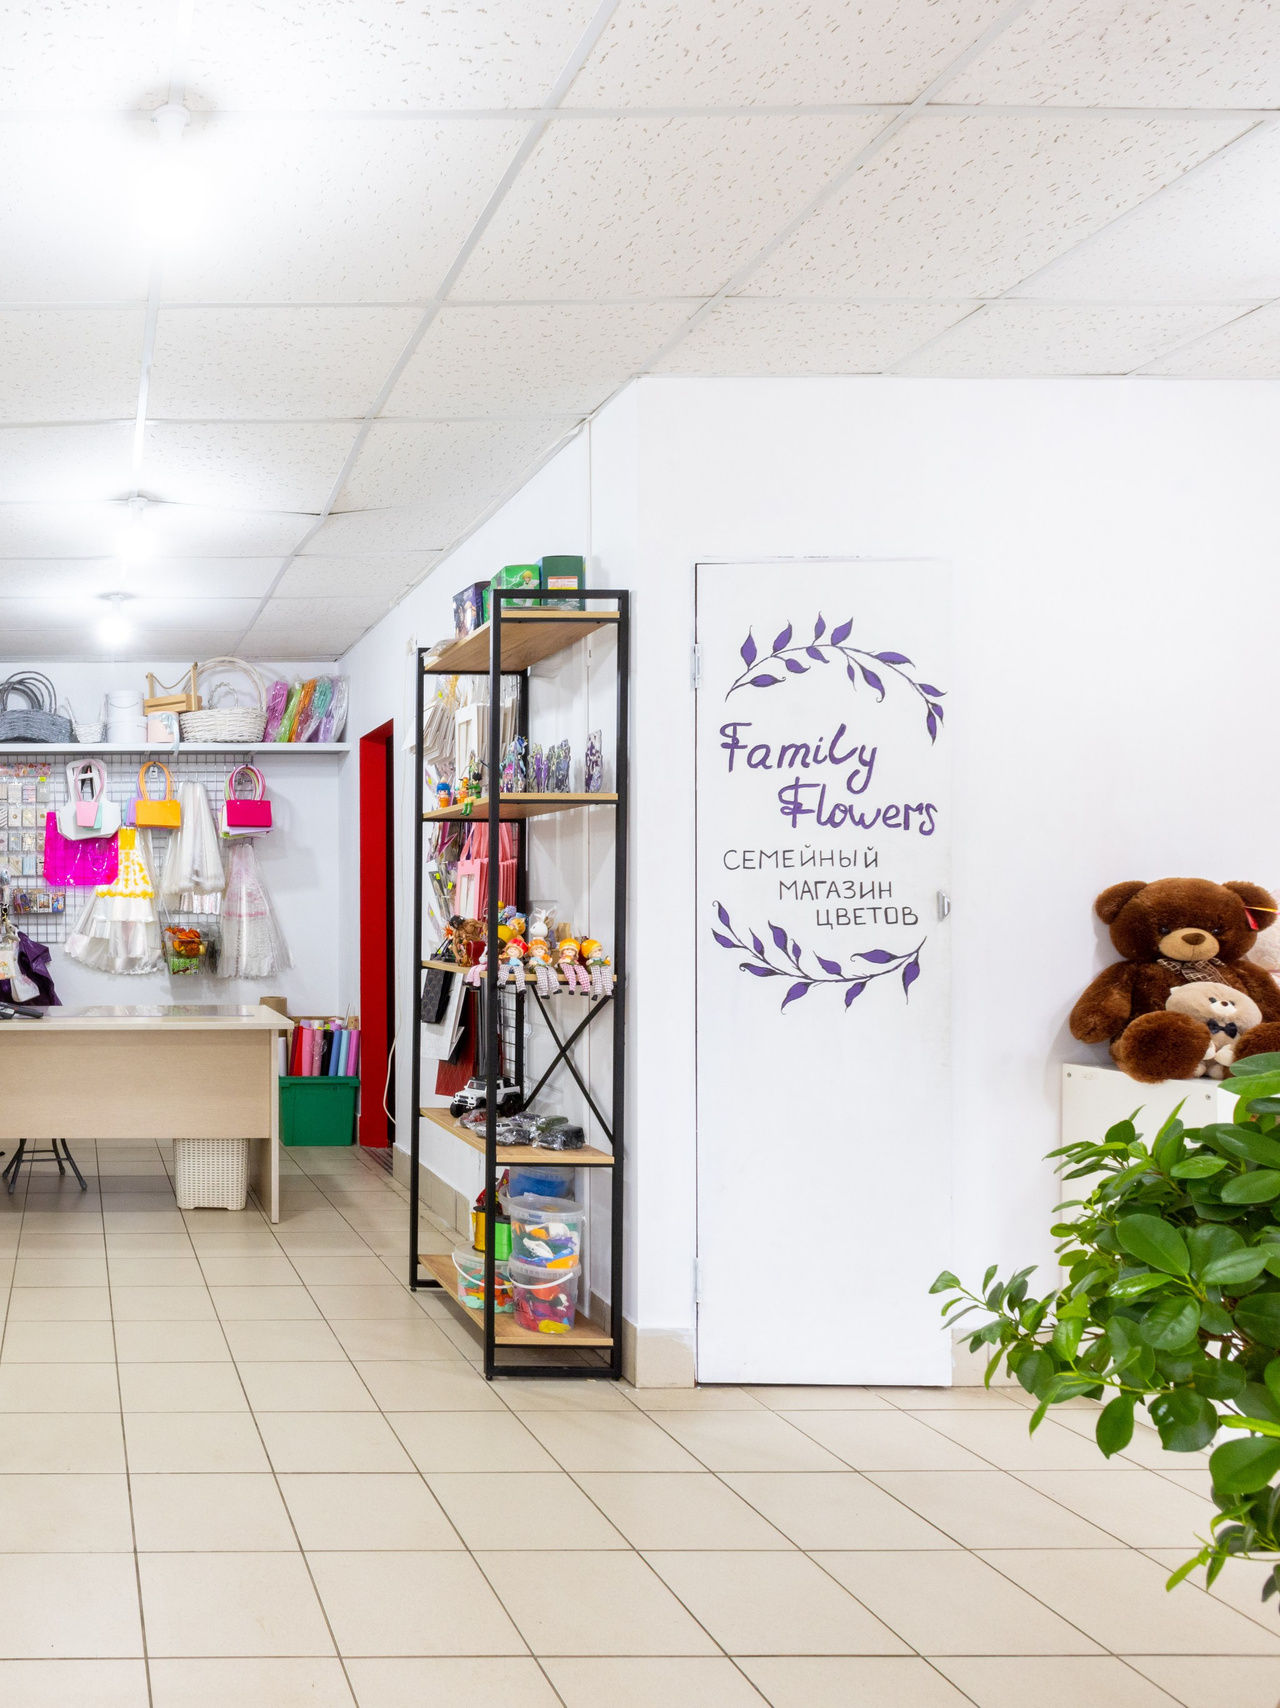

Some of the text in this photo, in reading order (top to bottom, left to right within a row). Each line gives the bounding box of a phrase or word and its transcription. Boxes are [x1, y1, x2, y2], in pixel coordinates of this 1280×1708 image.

[719, 722, 878, 794] Family
[777, 776, 939, 836] Flowers
[723, 844, 879, 870] СЕМЕЙНЫЙ
[779, 880, 893, 901] МАГАЗИН
[816, 906, 919, 929] ЦВЕТОВ
